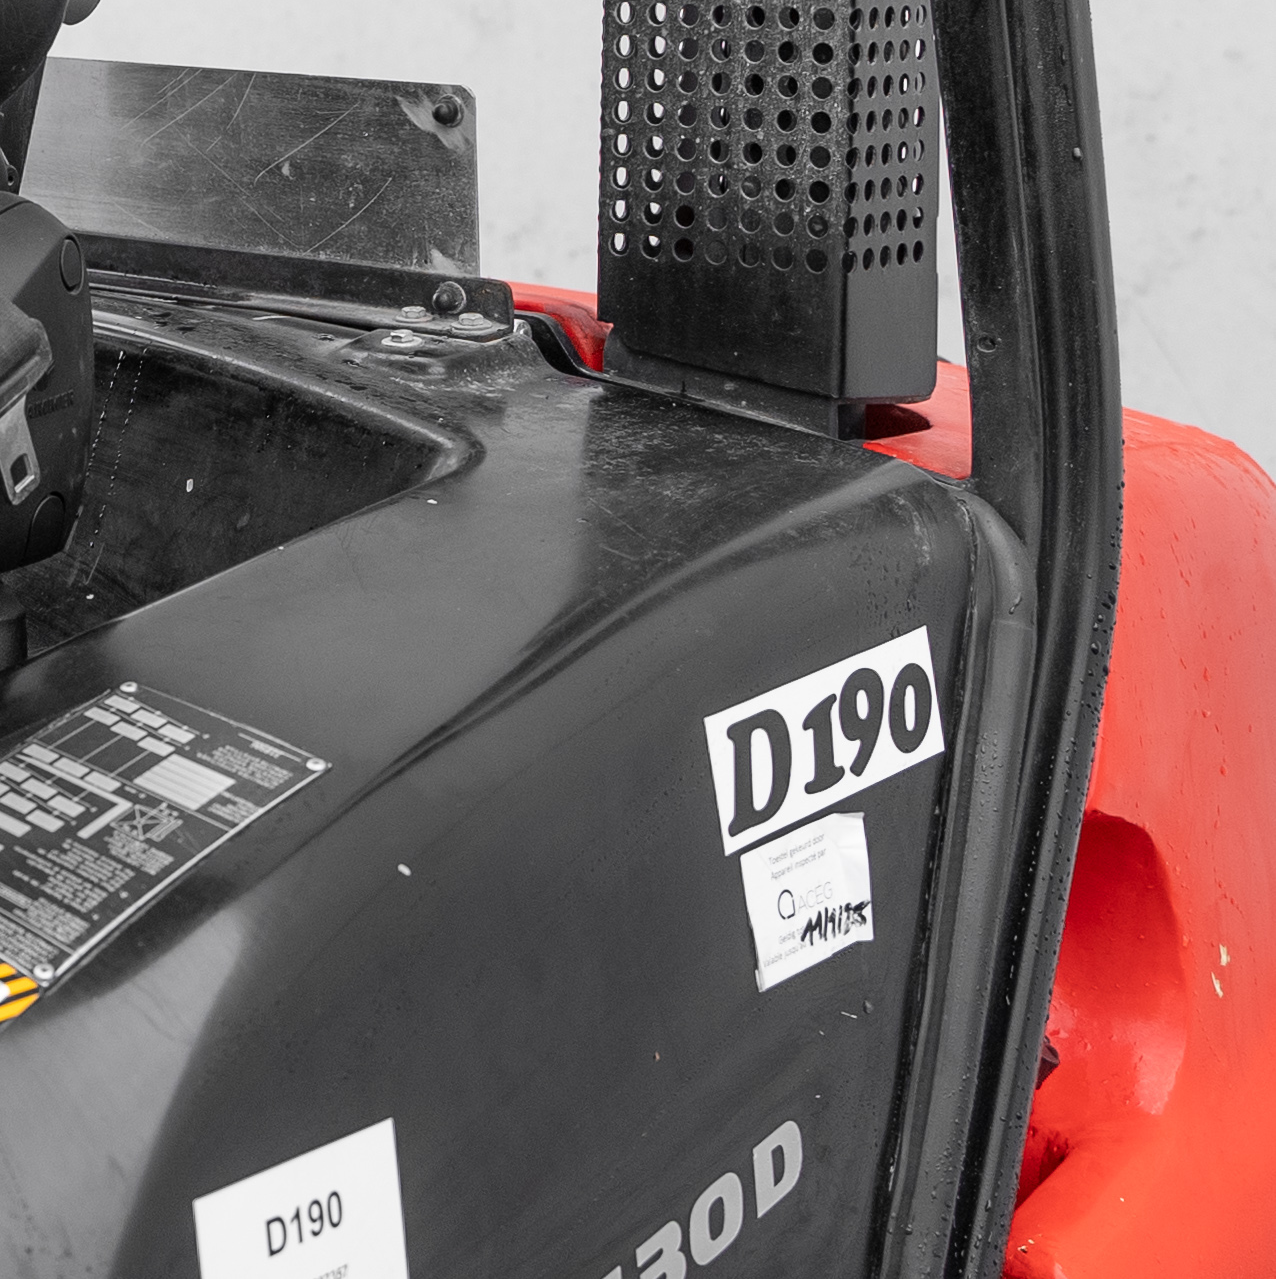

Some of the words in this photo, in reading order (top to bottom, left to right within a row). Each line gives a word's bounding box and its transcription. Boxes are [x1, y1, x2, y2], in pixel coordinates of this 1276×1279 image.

[726, 662, 932, 838] D190
[798, 881, 833, 911] ACEG
[266, 1190, 343, 1257] D190
[602, 1120, 803, 1279] 30D
